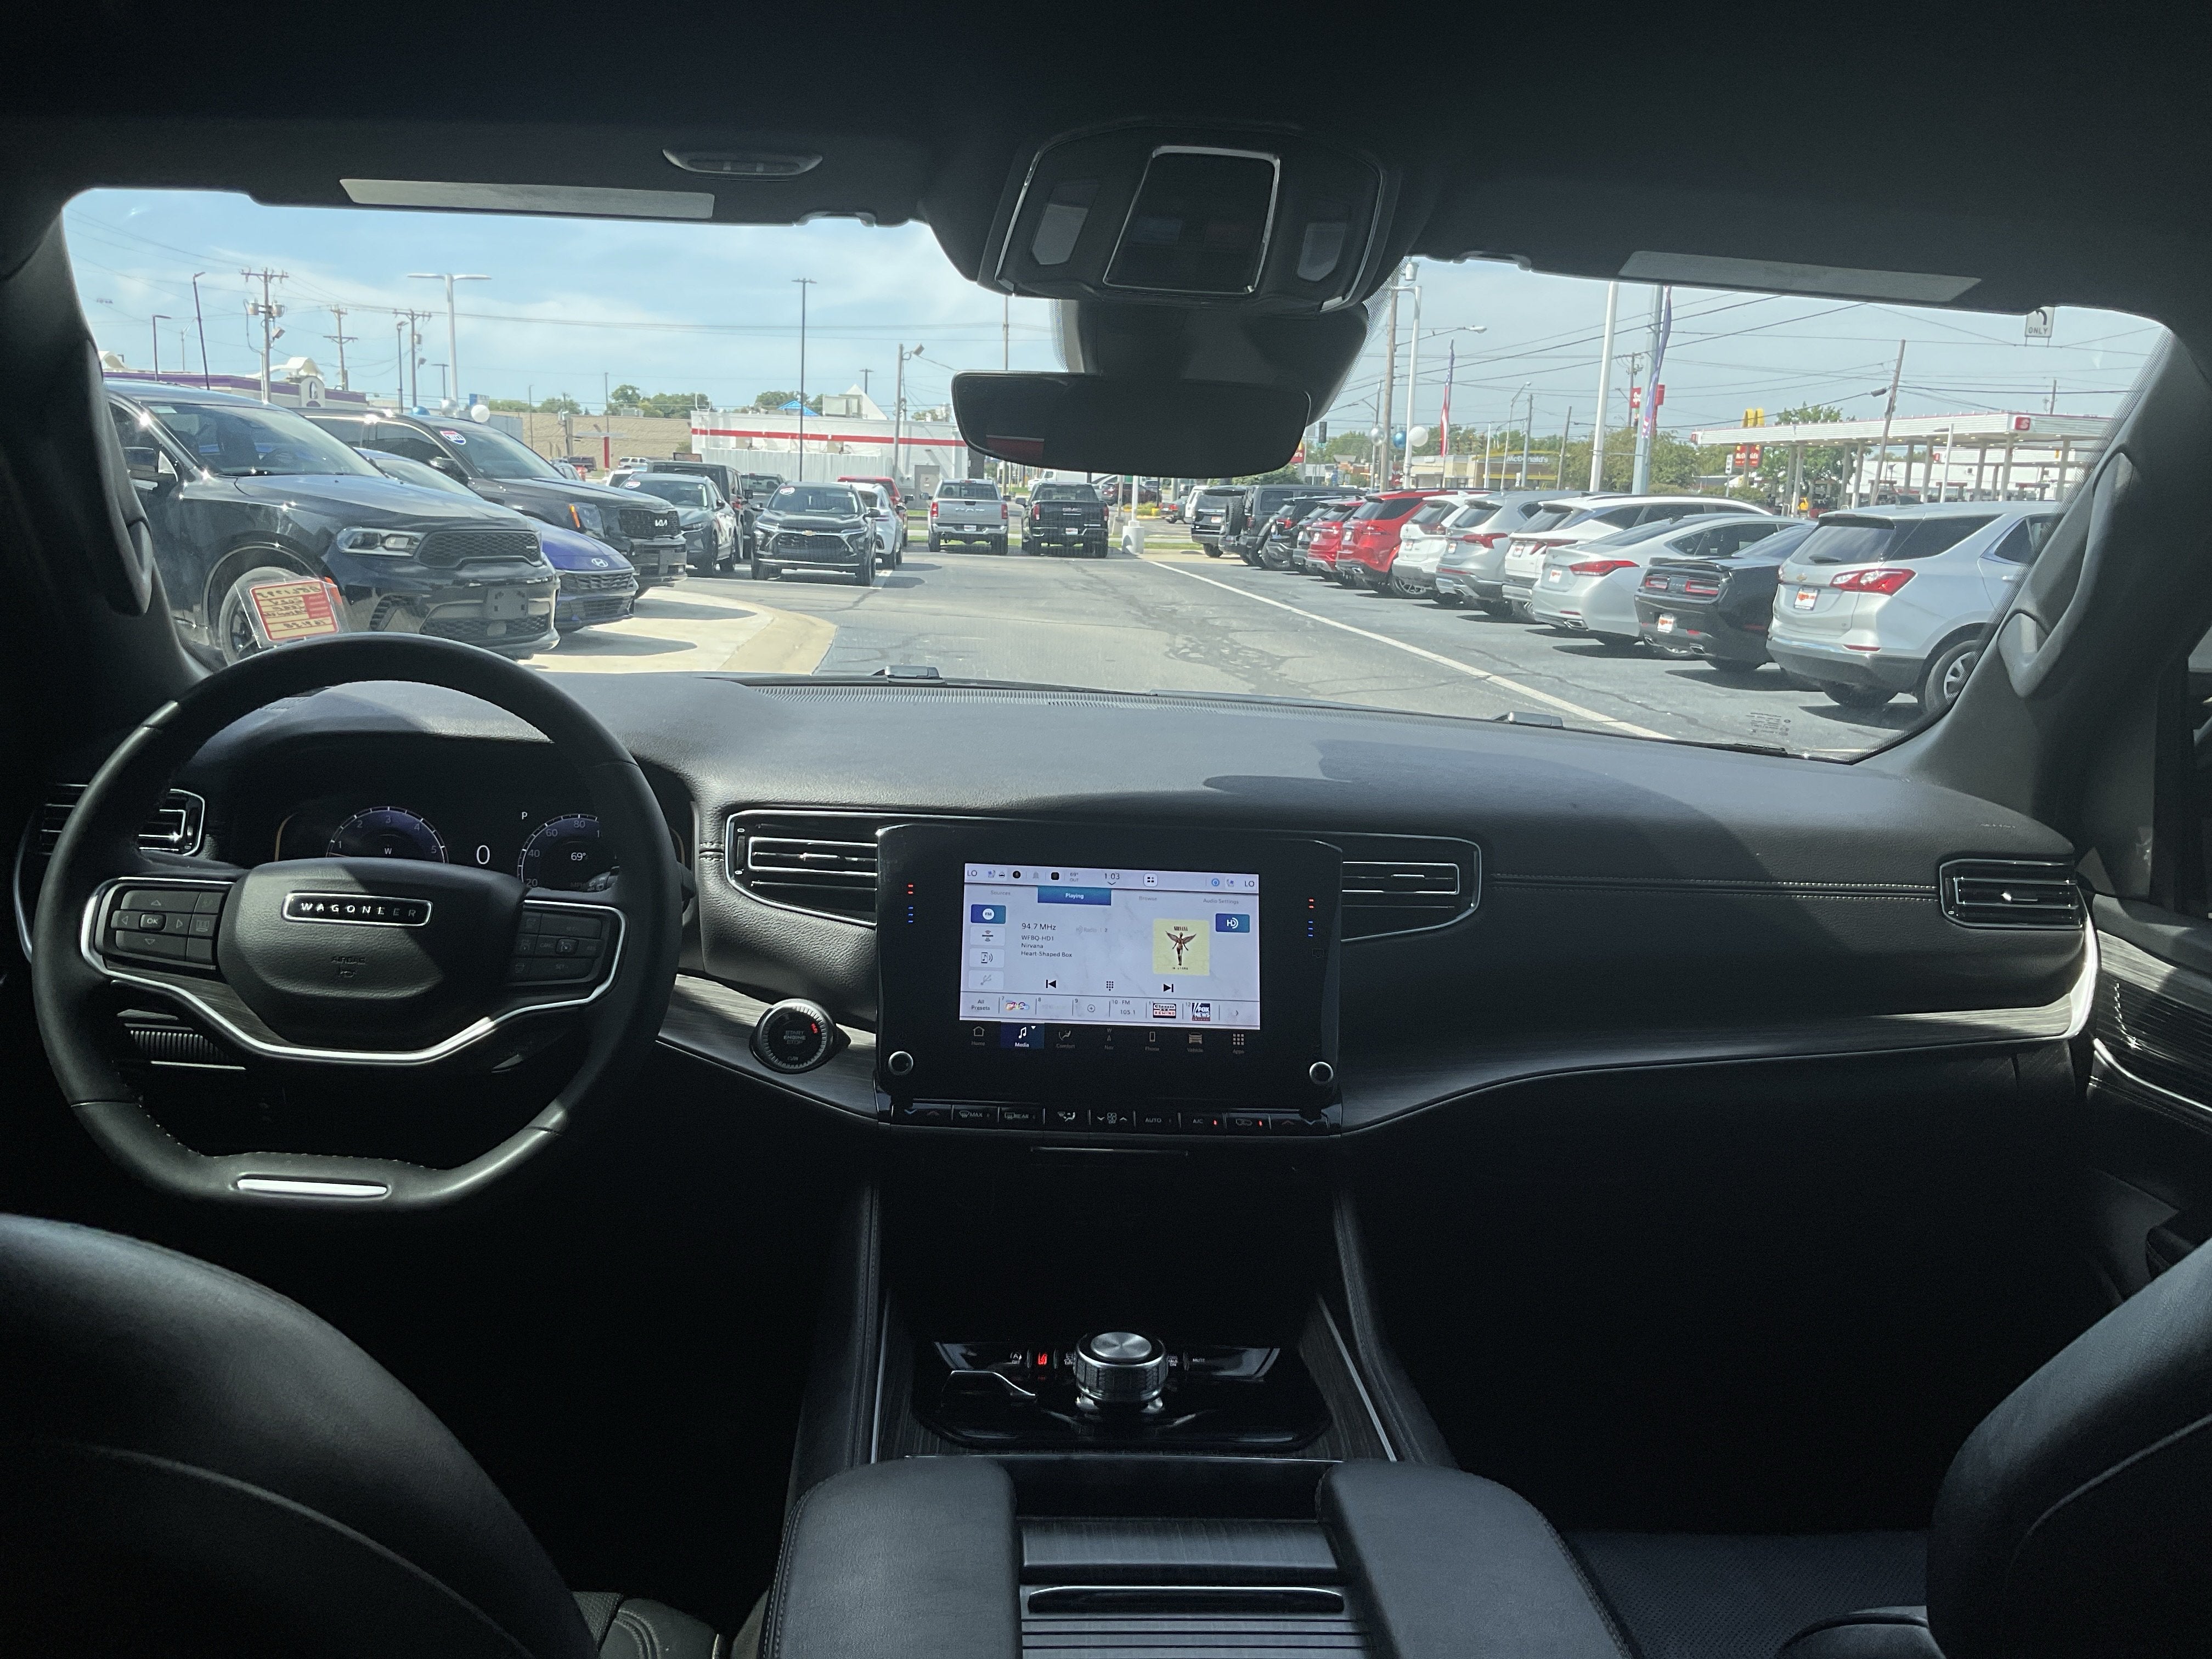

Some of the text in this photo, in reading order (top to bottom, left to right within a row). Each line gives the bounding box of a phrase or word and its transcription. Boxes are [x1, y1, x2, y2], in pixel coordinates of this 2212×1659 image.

[385, 815, 391, 823] 3
[521, 811, 528, 820] P
[356, 820, 363, 828] 2
[413, 823, 420, 832] 4
[546, 829, 558, 837] 60
[337, 840, 342, 849] 1
[431, 845, 437, 854] 5
[476, 845, 490, 865] 0
[526, 878, 538, 887] 20
[301, 902, 417, 917] WAGONEER
